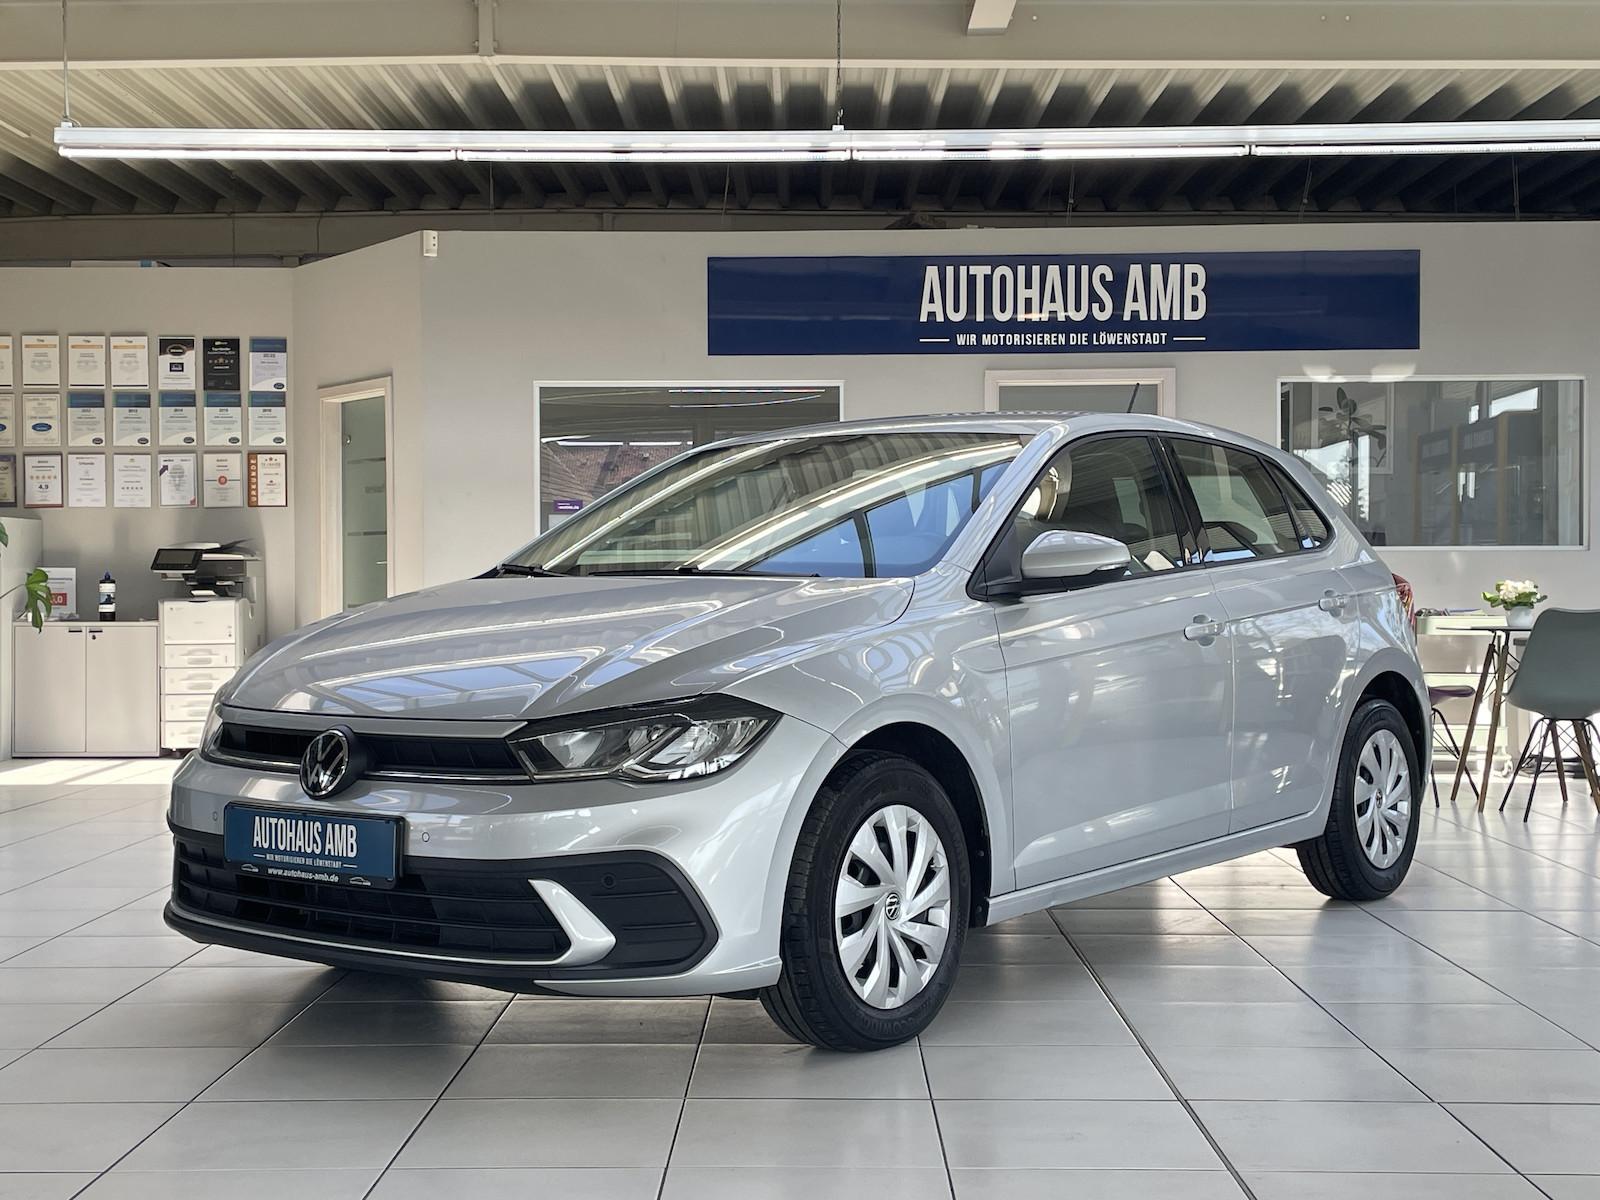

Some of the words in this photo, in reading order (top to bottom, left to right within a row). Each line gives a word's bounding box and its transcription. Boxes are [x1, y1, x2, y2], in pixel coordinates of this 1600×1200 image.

[920, 264, 1114, 322] AUTOHAUS
[1123, 263, 1207, 321] AMB
[956, 333, 977, 346] WIR
[981, 333, 1066, 346] MOTORISIEREN
[1069, 333, 1089, 346] DIE
[1093, 331, 1168, 345] LÖWENSTADT
[253, 815, 322, 855] AUTOHAUS
[324, 823, 357, 858] AMB
[267, 867, 340, 883] www.autohaus-amb.de
